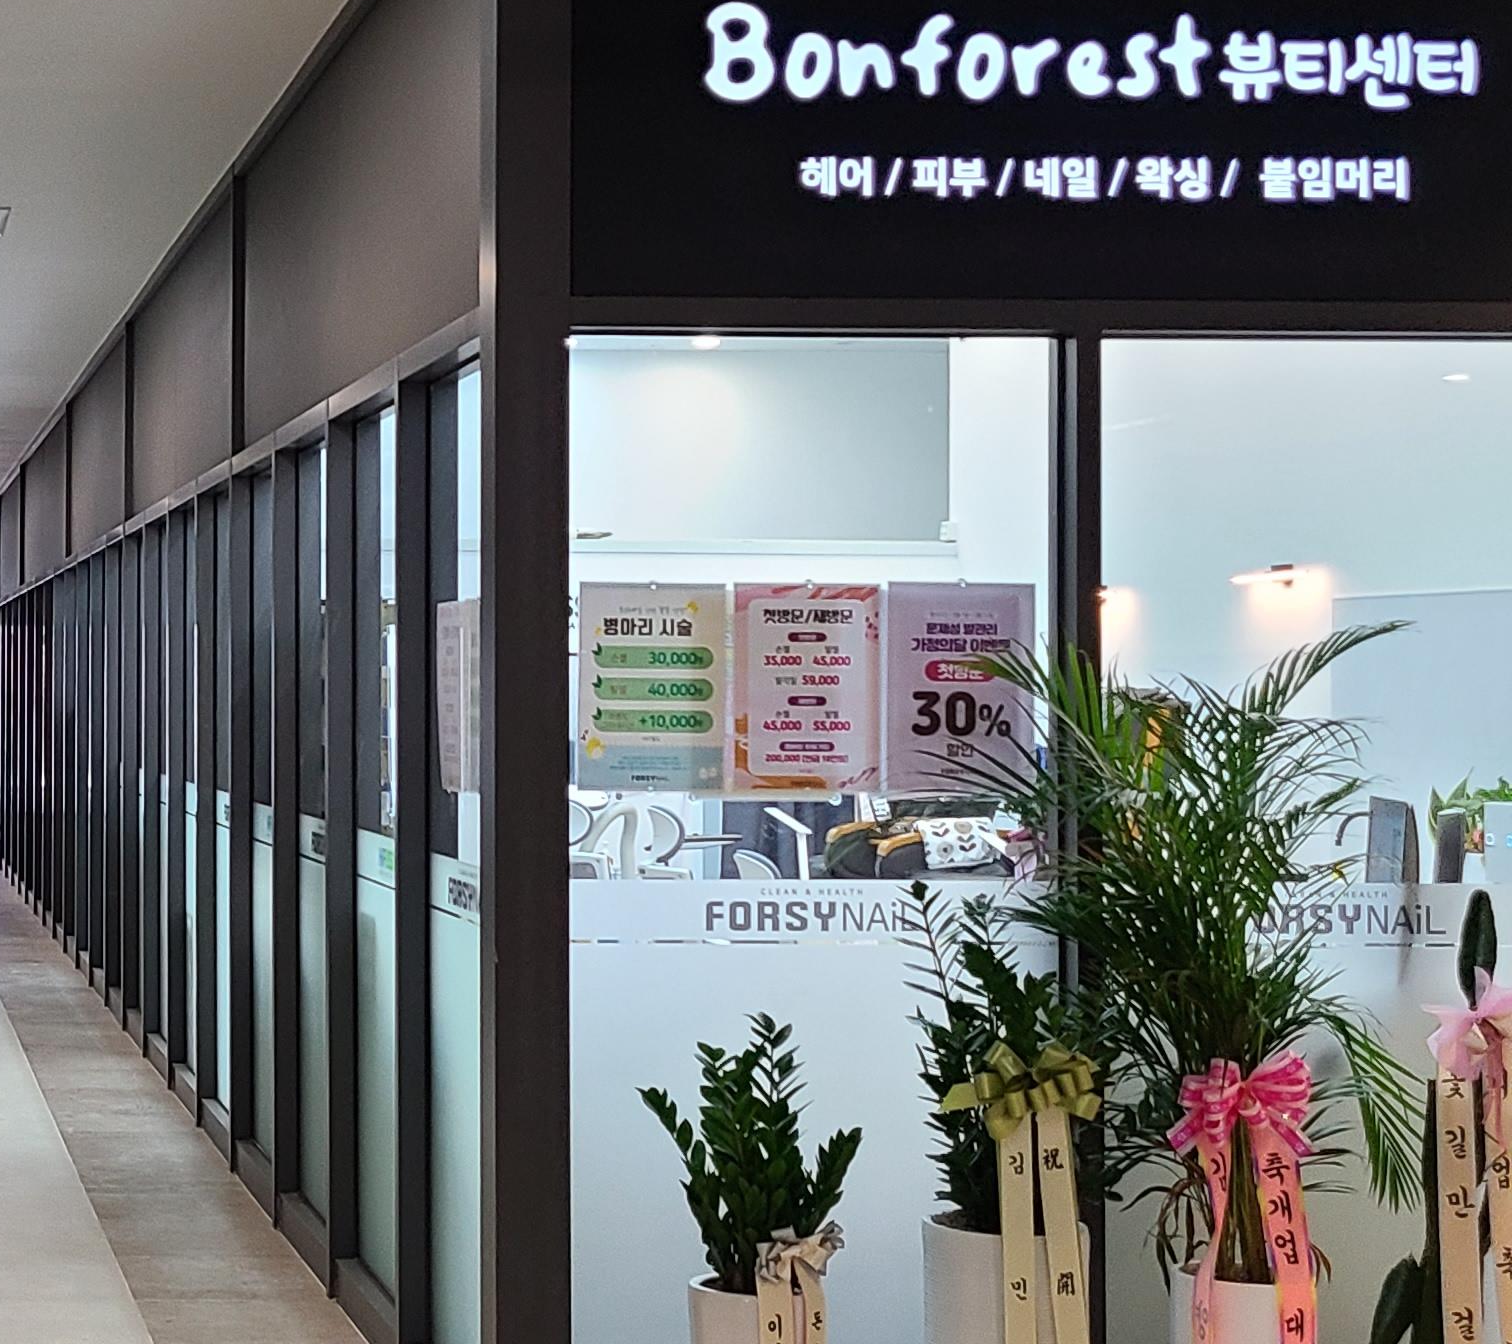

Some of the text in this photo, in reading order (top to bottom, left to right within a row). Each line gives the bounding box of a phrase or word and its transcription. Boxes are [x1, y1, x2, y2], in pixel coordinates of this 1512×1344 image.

[704, 1, 1479, 110] Bonforest 뷰티센터
[799, 156, 875, 198] 헤어
[910, 156, 987, 198] 피부
[1023, 156, 1098, 199] 네일
[1134, 156, 1210, 199] 왁싱
[659, 618, 693, 637] 시술
[763, 655, 802, 666] 35,000
[802, 675, 840, 686] 59,000
[911, 691, 1011, 736] 30%
[813, 720, 851, 732] 55,000
